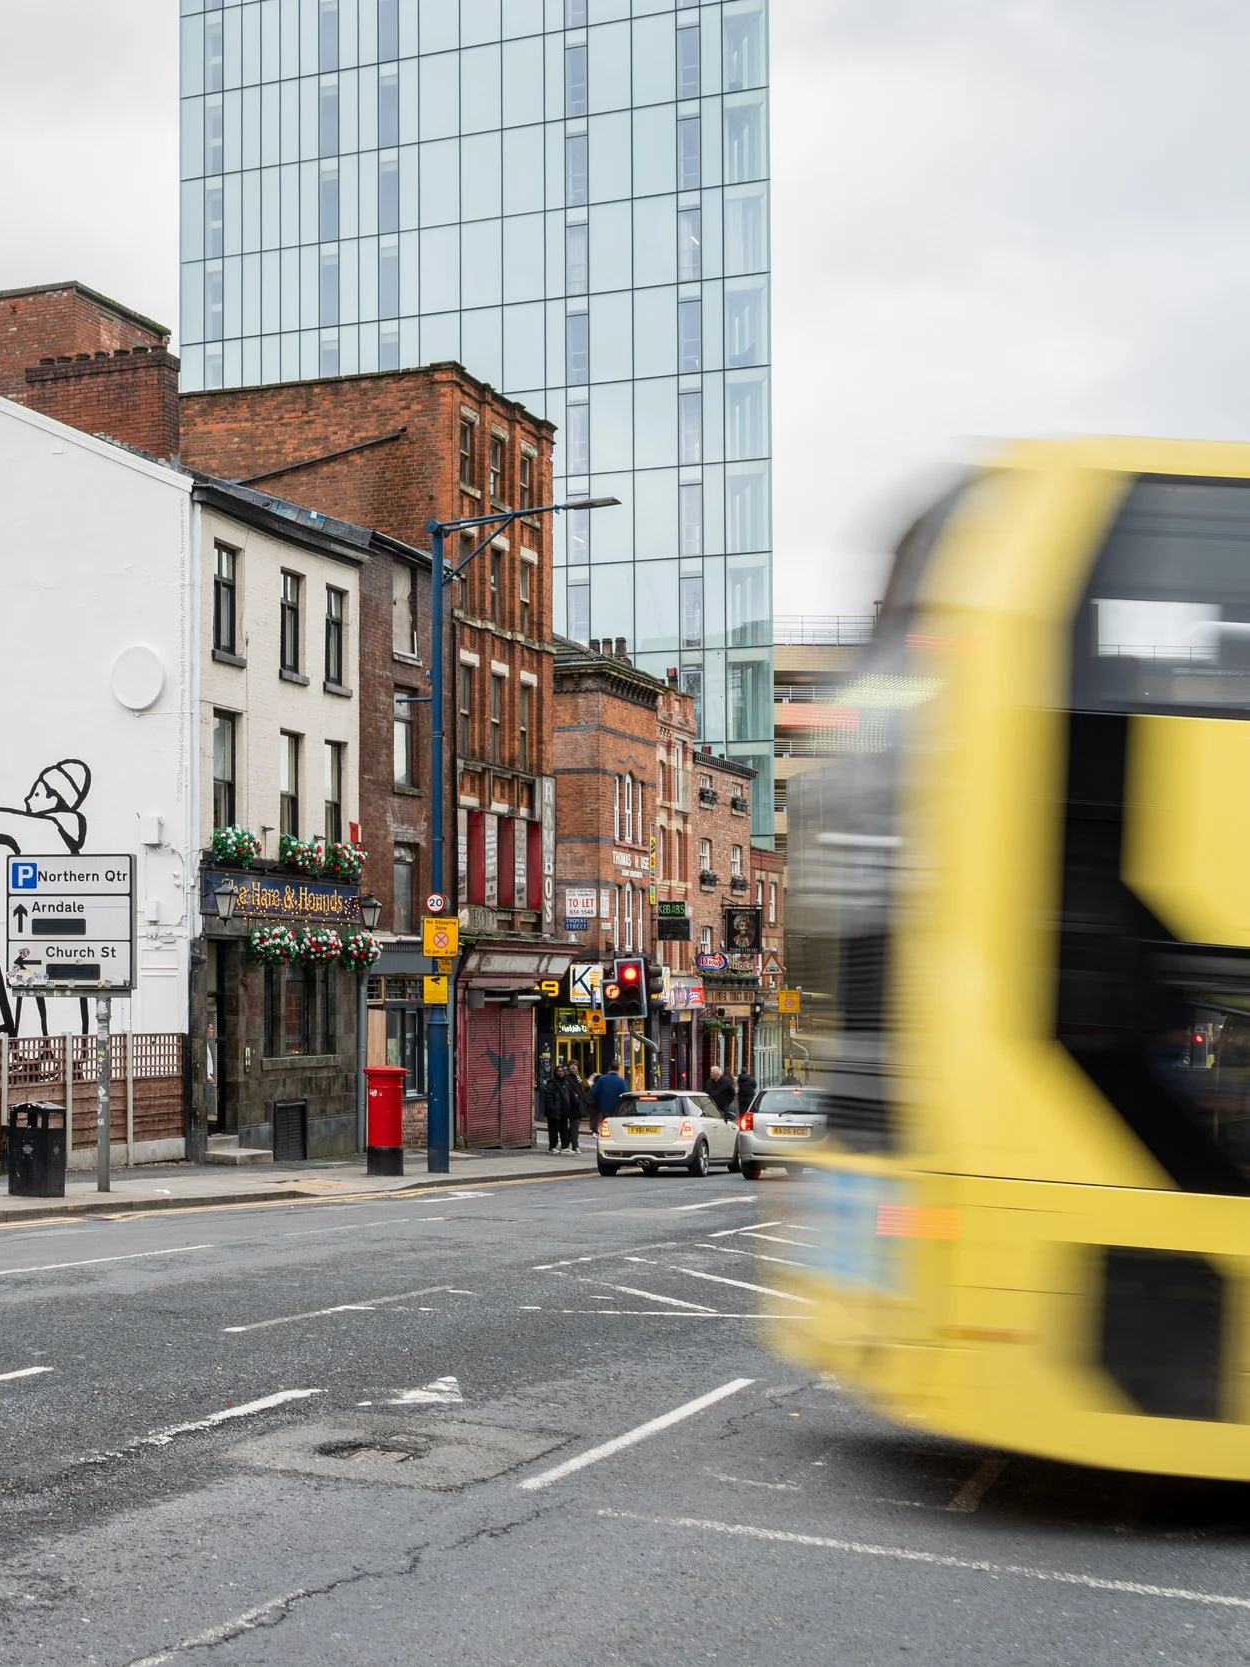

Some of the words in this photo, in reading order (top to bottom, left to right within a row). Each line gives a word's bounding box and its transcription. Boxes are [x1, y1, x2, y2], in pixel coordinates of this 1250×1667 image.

[17, 865, 34, 887] P
[38, 871, 99, 881] Northern
[105, 870, 127, 882] Qtr
[251, 881, 280, 907] Hare
[284, 885, 296, 910] &
[299, 886, 344, 912] Hounds
[32, 901, 84, 912] Arndale
[429, 899, 443, 907] 20
[567, 898, 579, 908] TO
[581, 898, 595, 908] LET
[46, 946, 94, 957] Church
[101, 947, 116, 957] St
